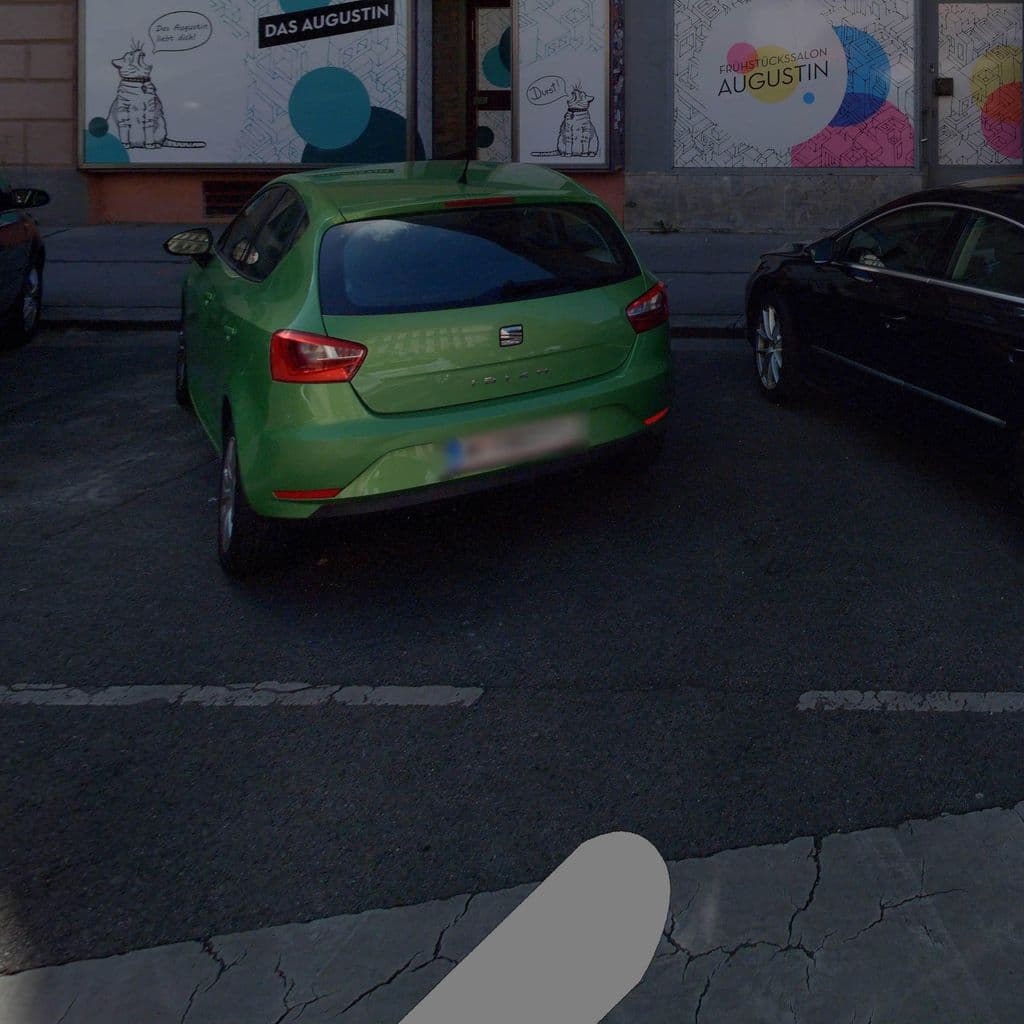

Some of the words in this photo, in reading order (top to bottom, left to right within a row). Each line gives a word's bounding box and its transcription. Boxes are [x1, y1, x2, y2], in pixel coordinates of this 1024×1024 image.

[265, 20, 298, 38] DAS
[301, 4, 389, 32] AUGUSTIN
[718, 60, 829, 96] AUGUSTIN
